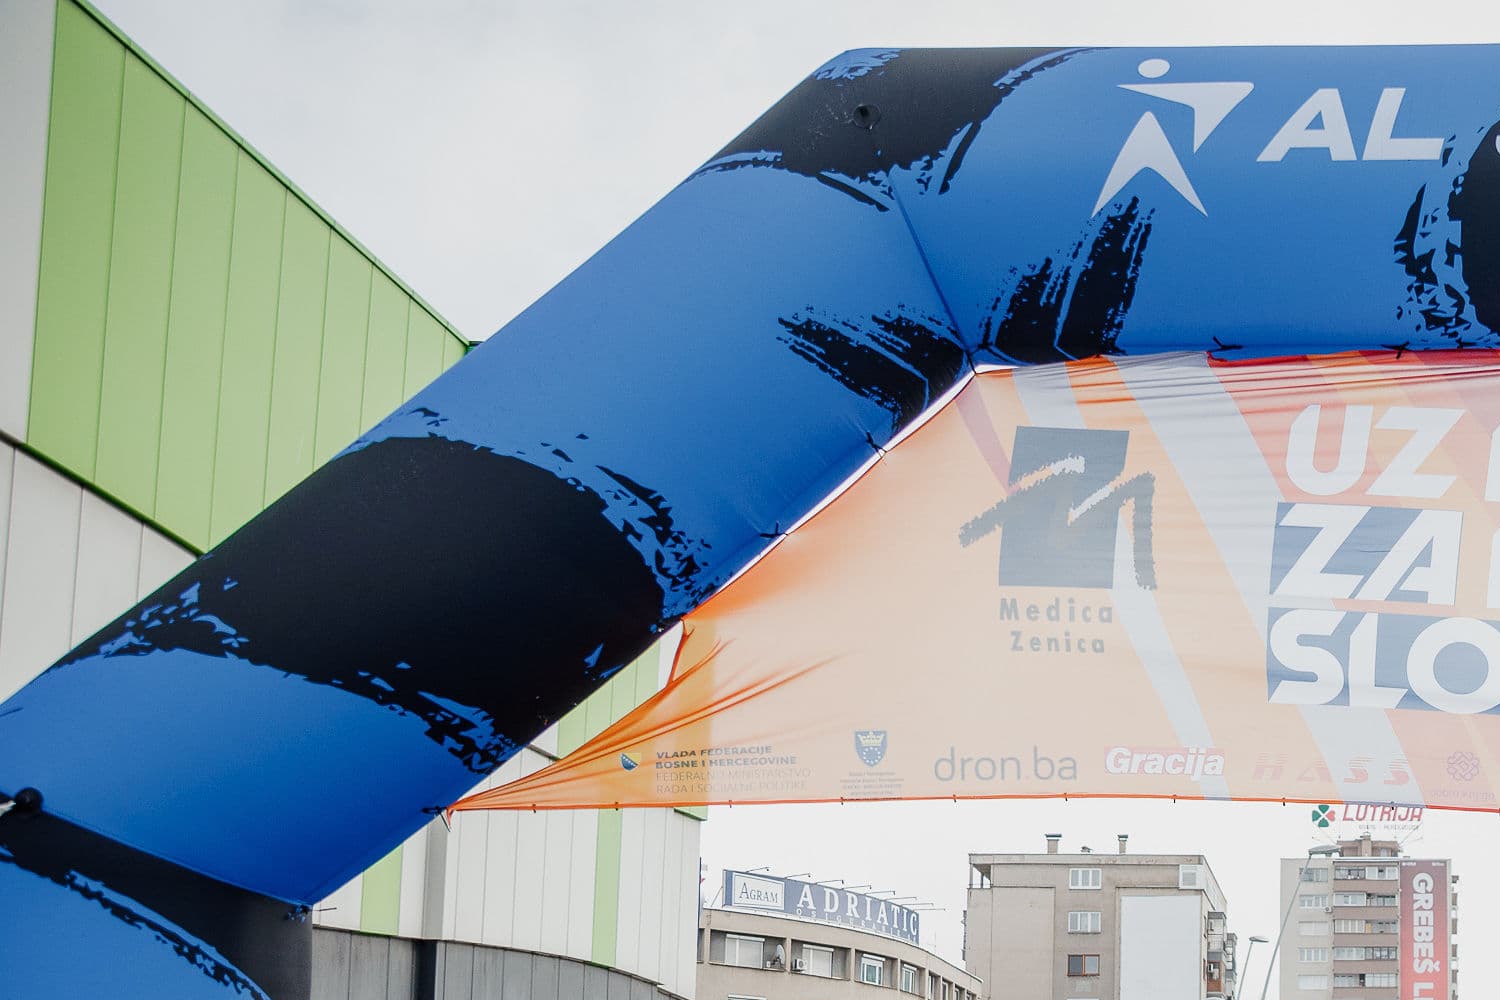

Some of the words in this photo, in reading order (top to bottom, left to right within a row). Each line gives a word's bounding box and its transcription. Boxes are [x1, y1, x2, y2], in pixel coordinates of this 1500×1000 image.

[1256, 87, 1446, 163] AL
[1285, 402, 1467, 503] UZ
[1277, 503, 1461, 604] ZA
[999, 597, 1113, 623] Medica
[1010, 630, 1105, 653] Zenica
[656, 751, 698, 760] VLADA
[700, 745, 773, 757] FEDERACIJE
[656, 759, 699, 769] BOSNE
[709, 755, 798, 767] HERCEGOVINE
[933, 744, 1080, 783] dron.ba
[1105, 746, 1226, 782] Gracija
[1342, 802, 1424, 822] LUTRIJA
[797, 884, 919, 936] ADRIATIC
[1411, 872, 1441, 974] GREBEŠ
